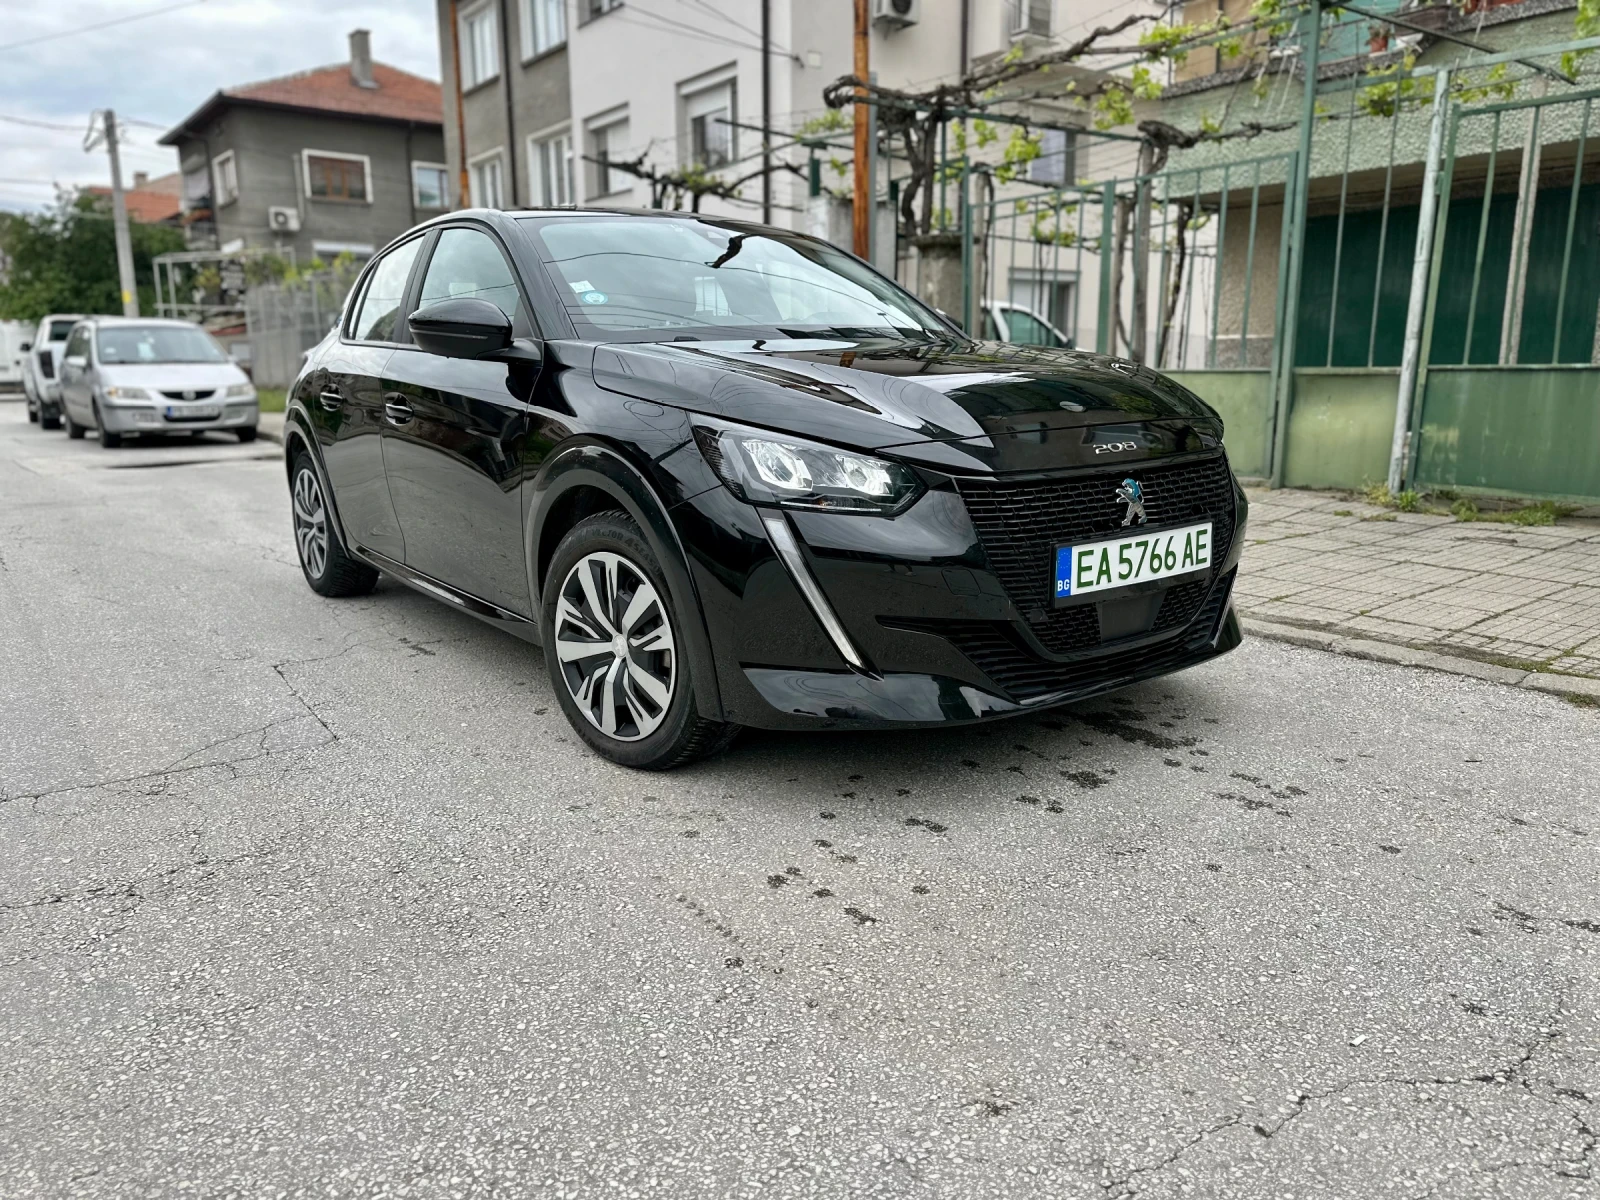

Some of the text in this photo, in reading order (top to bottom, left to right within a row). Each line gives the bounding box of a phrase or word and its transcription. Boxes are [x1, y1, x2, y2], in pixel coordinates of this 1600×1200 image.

[1093, 442, 1137, 454] 208
[591, 528, 663, 576] VECTOR 4SEASO
[1077, 529, 1208, 588] EA 5766 AE
[1057, 579, 1070, 592] BG
